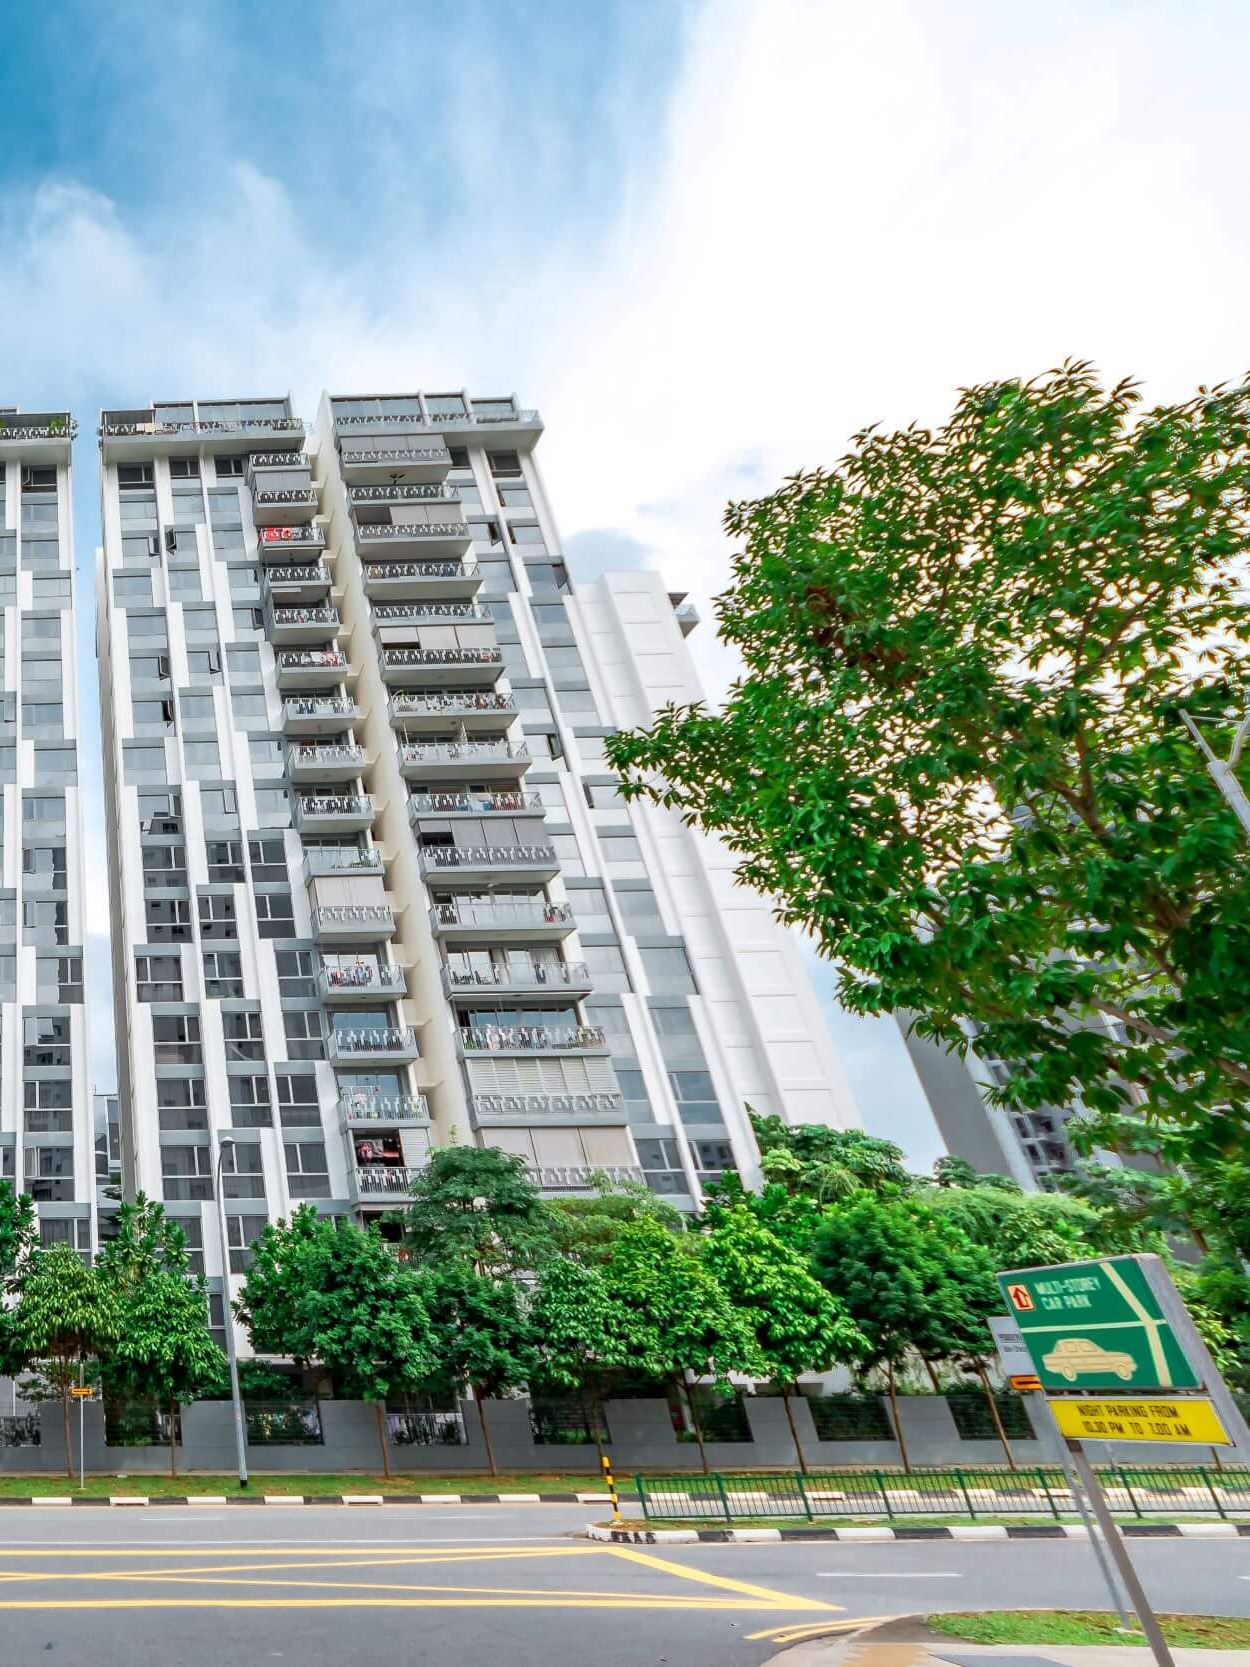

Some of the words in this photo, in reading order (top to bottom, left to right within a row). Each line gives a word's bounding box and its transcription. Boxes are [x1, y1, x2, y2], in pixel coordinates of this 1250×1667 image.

[1034, 1277, 1101, 1294] MULTI-STOREY
[1041, 1296, 1063, 1310] CAR
[1063, 1295, 1092, 1309] PARK
[1076, 1405, 1104, 1416] NIGHT
[1105, 1405, 1148, 1417] PARKING
[1149, 1405, 1179, 1417] FROM
[1108, 1422, 1126, 1434] PM
[1129, 1422, 1144, 1435] TO
[1174, 1423, 1191, 1435] AM
